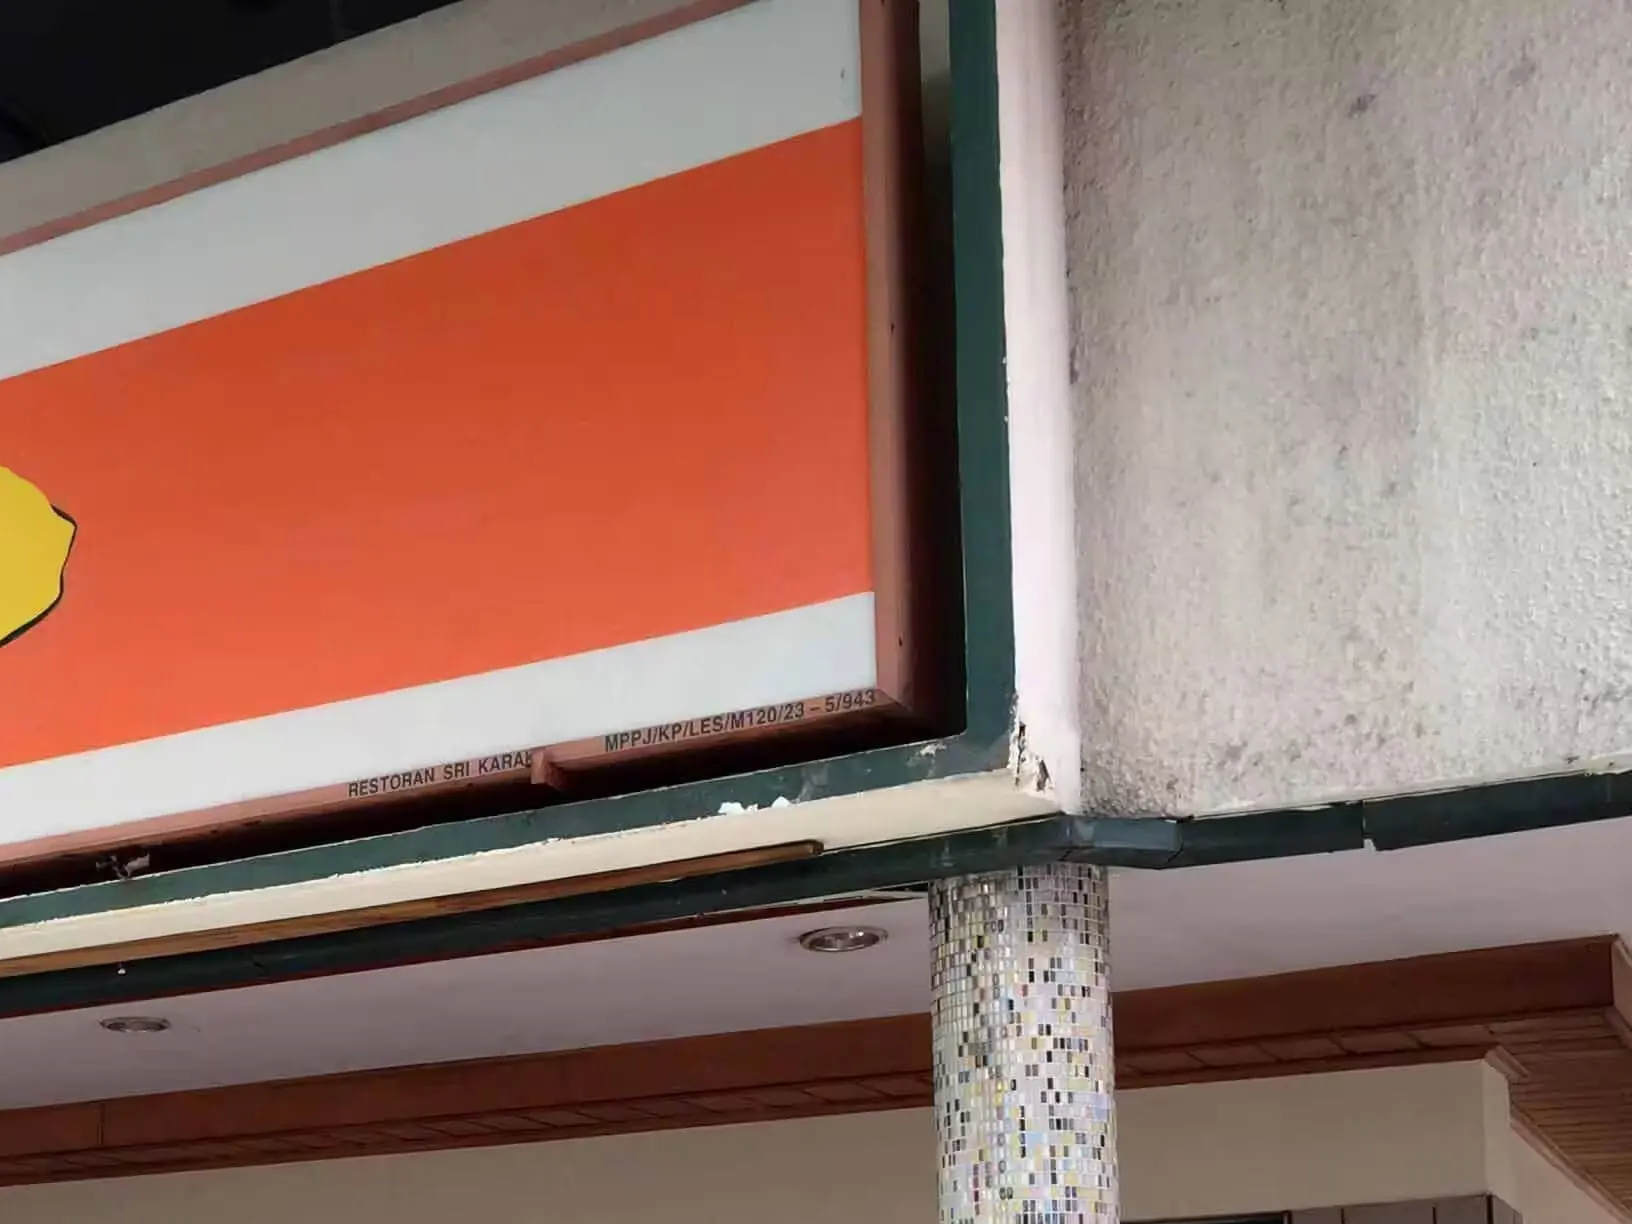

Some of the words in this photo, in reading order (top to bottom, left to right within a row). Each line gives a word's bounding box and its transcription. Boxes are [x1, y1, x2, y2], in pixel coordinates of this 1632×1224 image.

[604, 701, 805, 754] MPPJ/KP/LES/M120/23
[824, 689, 877, 714] 5/943
[347, 767, 435, 799] RESTORAN
[443, 760, 471, 783] SRI
